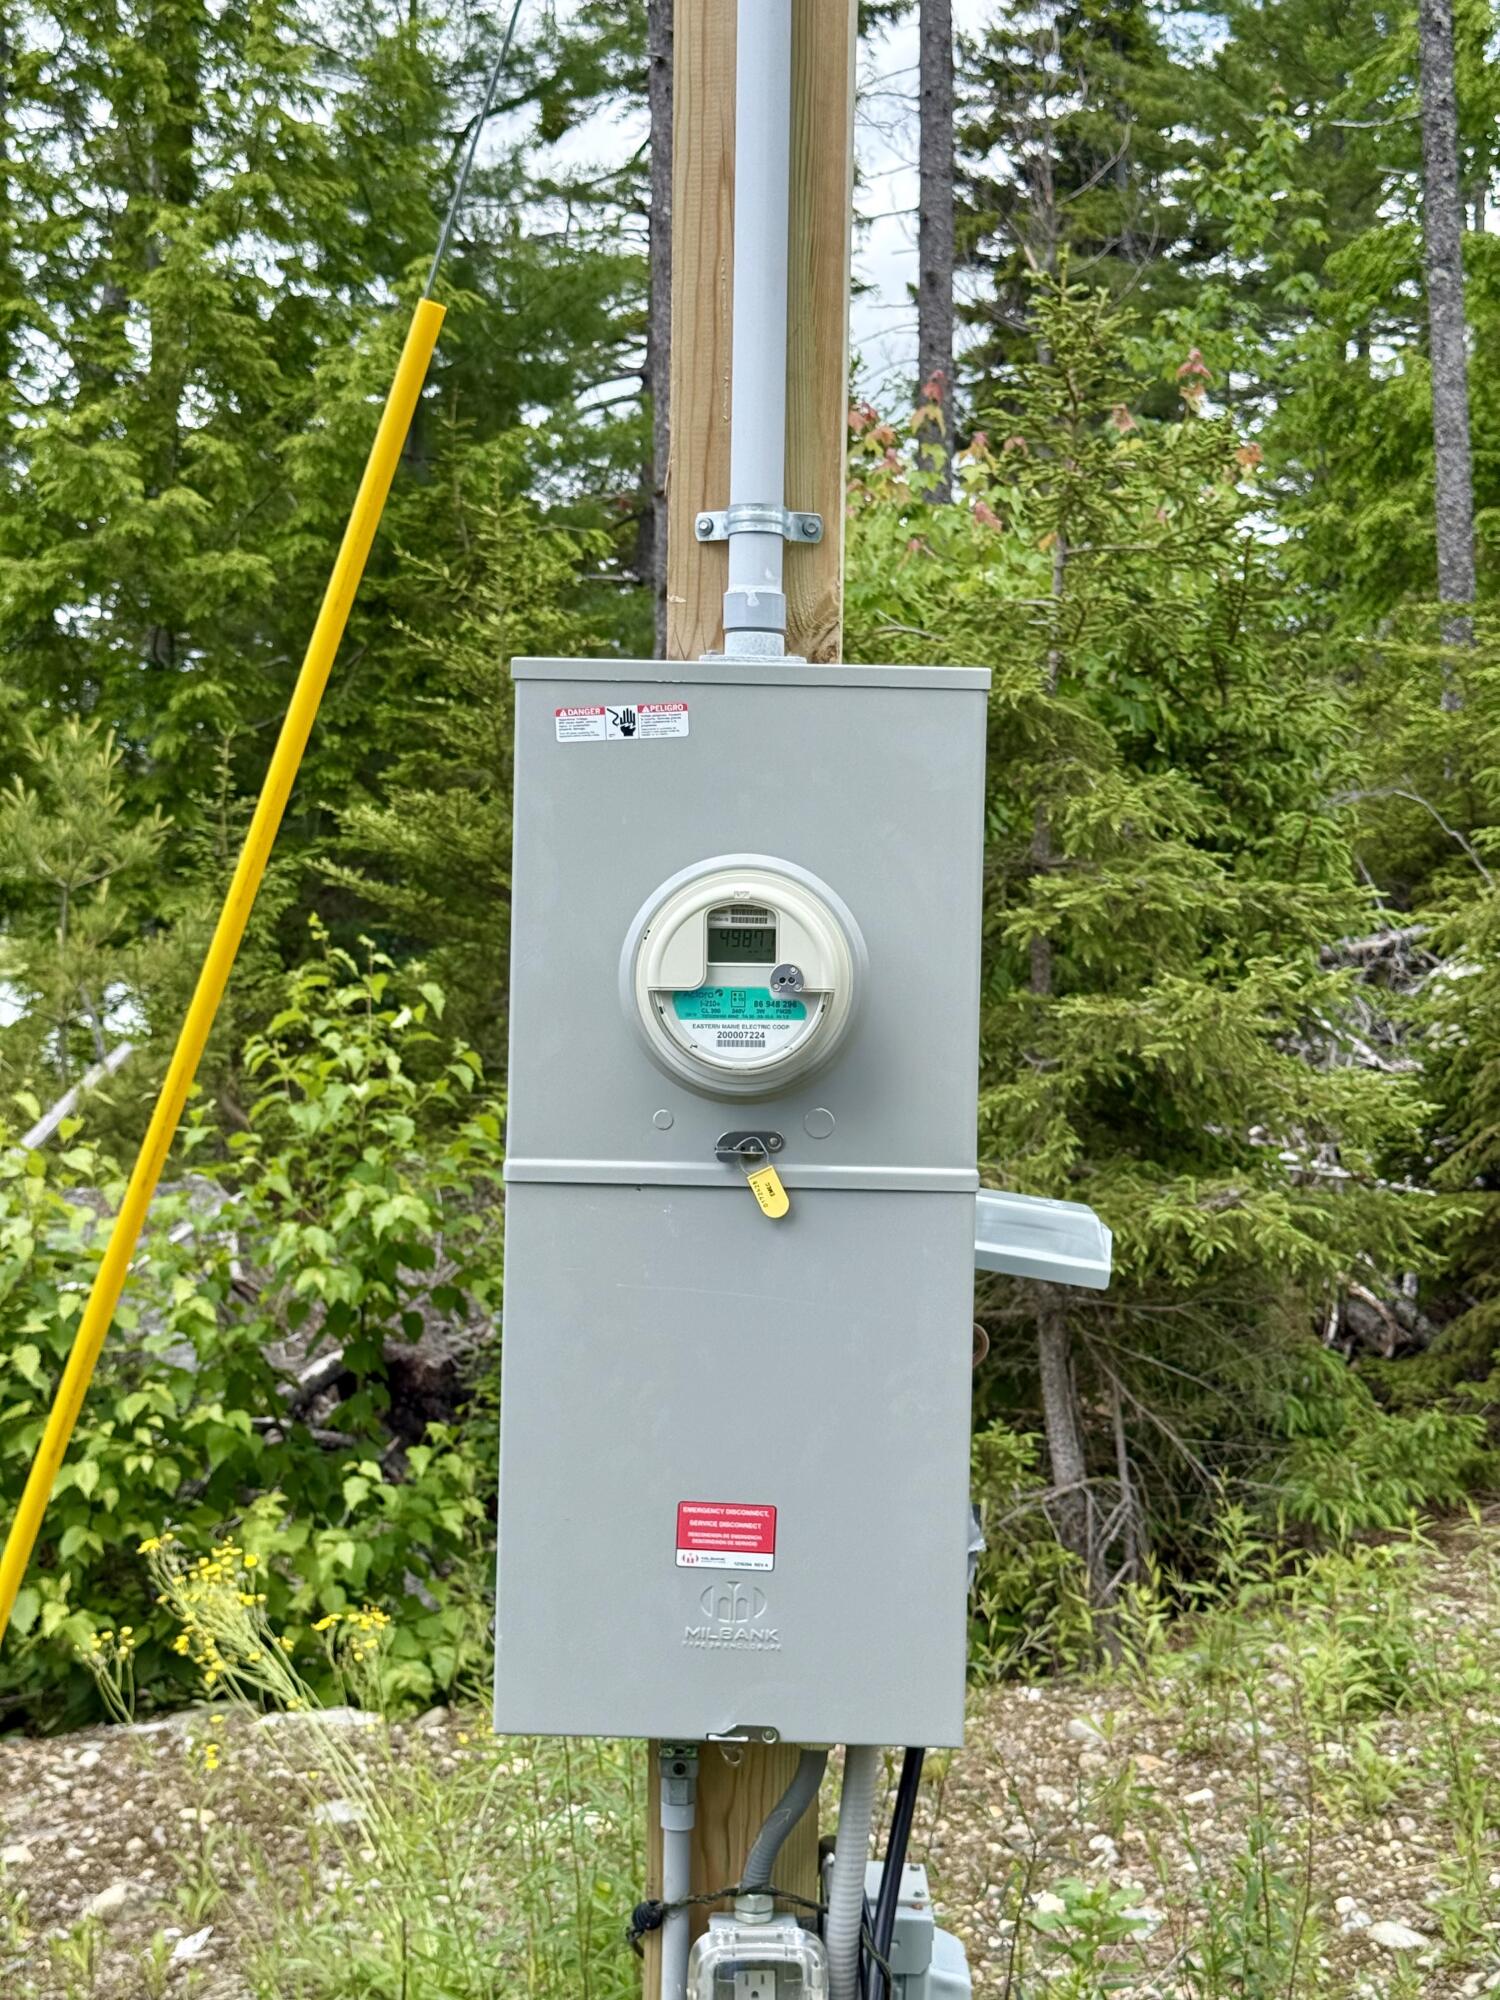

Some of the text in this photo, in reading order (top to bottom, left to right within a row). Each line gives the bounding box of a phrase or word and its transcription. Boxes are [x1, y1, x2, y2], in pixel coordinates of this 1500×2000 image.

[567, 707, 601, 716] DANGER
[650, 703, 684, 712] PELIGRO
[716, 1031, 765, 1039] 200007224
[682, 1506, 725, 1515] EMERGENCY
[688, 1519, 762, 1530] SERVICE DISCONNECT
[684, 1626, 780, 1642] MILBANK
